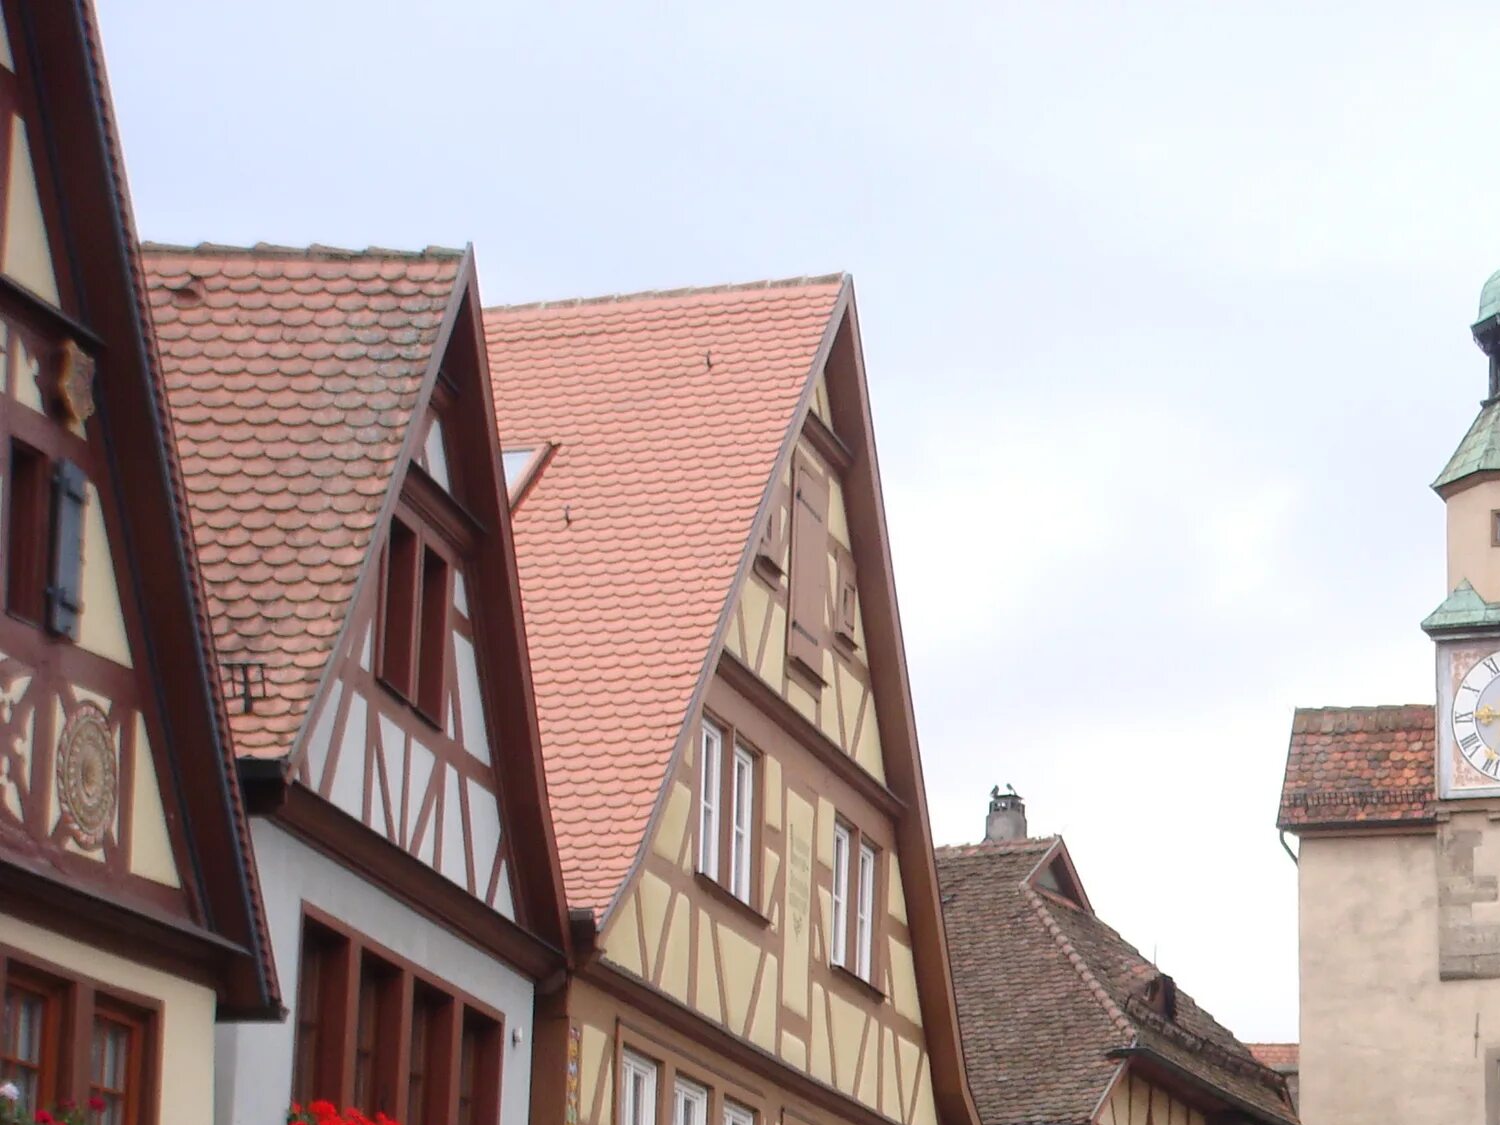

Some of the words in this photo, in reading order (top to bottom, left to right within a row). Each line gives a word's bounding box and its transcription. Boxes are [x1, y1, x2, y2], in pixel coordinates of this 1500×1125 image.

[1483, 657, 1500, 677] XI
[1462, 681, 1480, 696] X
[1454, 711, 1474, 723] IX
[1460, 732, 1482, 759] VIII
[1482, 758, 1500, 777] VII
